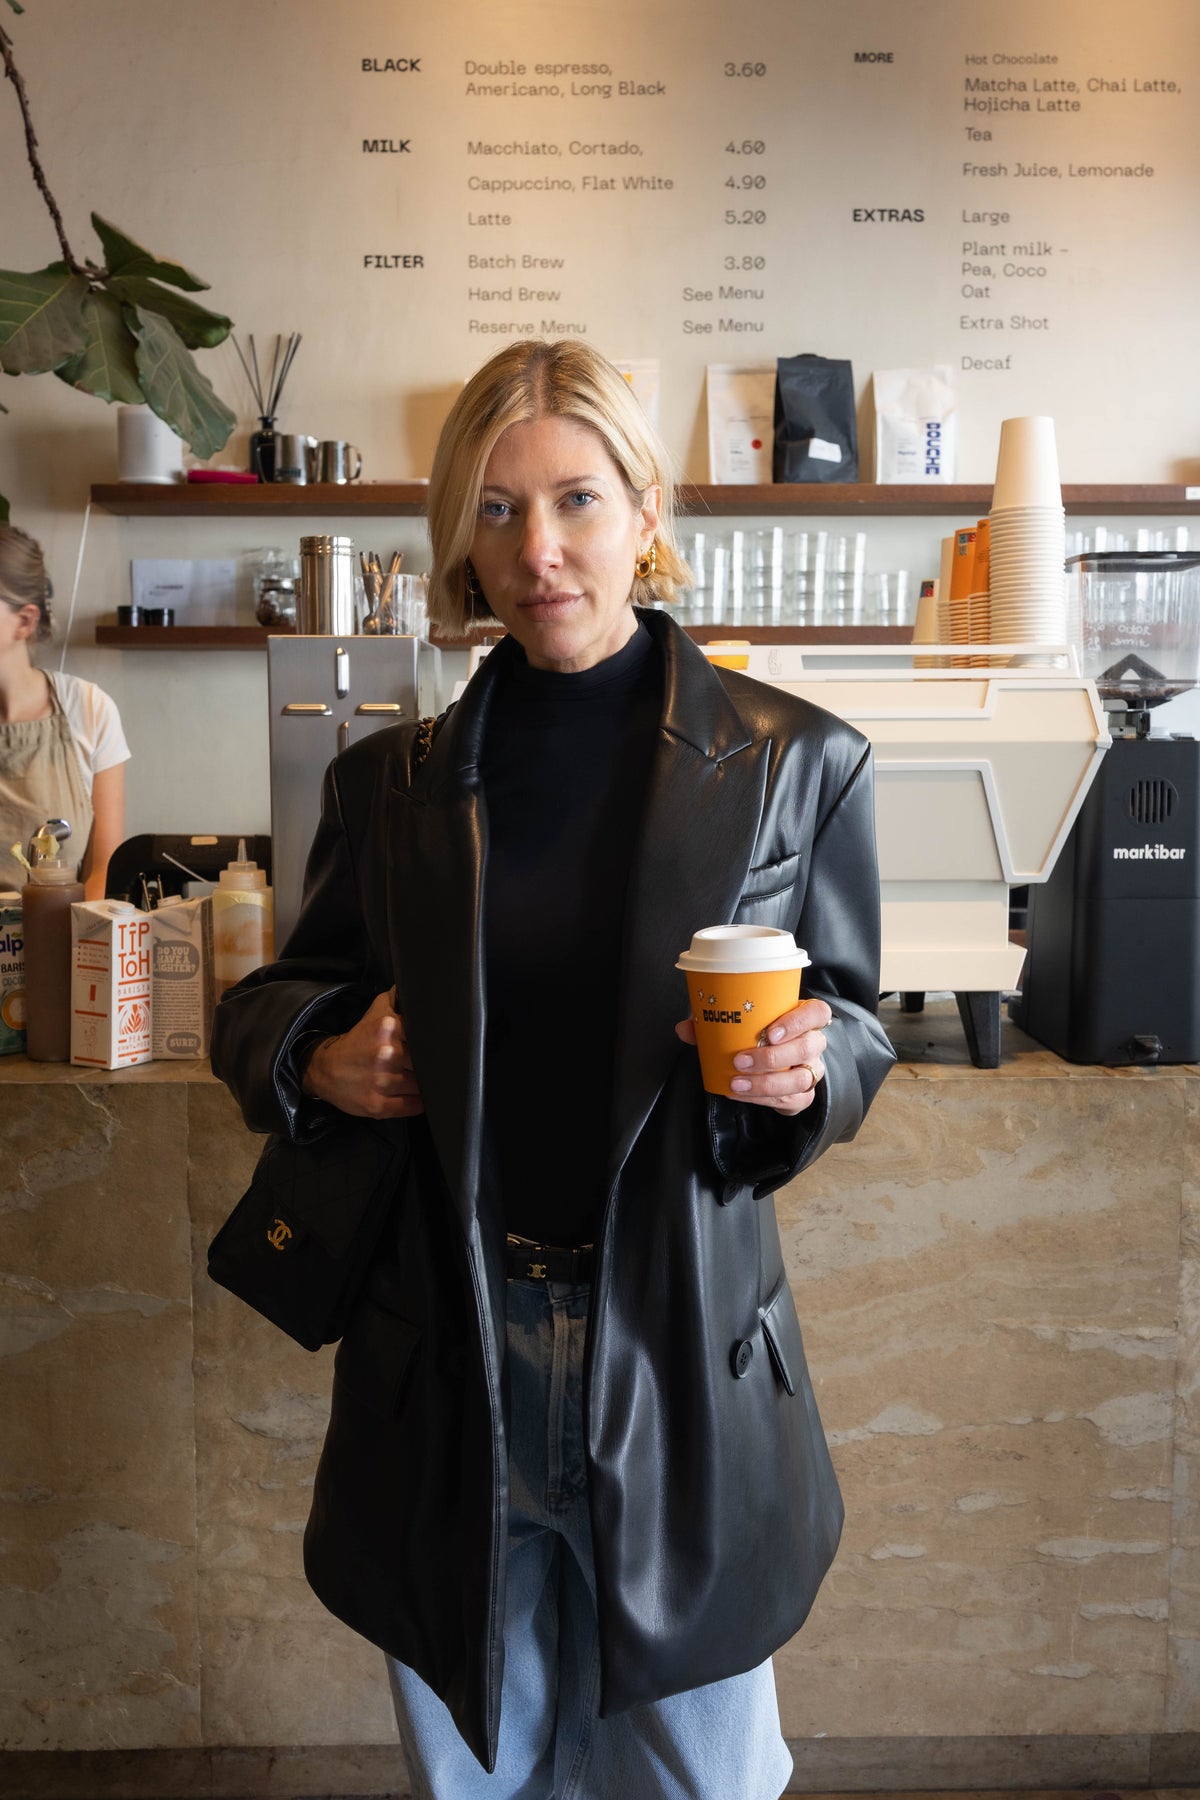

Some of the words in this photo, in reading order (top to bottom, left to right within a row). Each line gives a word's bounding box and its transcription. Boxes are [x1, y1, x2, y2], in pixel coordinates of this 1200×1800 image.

[854, 51, 894, 63] MORE
[965, 54, 988, 65] Hot
[992, 53, 1059, 65] Chocolate
[362, 58, 422, 73] BLACK
[464, 60, 526, 76] Double
[534, 62, 613, 78] espresso,
[724, 62, 767, 78] 3.60
[465, 81, 565, 98] Americano,
[571, 81, 612, 99] Long
[618, 80, 667, 96] Black
[965, 78, 1027, 93] Matcha
[1033, 78, 1081, 94] Latte,
[1087, 78, 1127, 93] Chai
[1133, 79, 1182, 94] Latte,
[963, 96, 1031, 114] Hojicha
[1037, 97, 1081, 112] Latte
[965, 127, 993, 142] Tea
[362, 139, 412, 153] MILK
[467, 141, 562, 156] Macchiato,
[569, 140, 644, 156] Cortado,
[724, 140, 766, 156] 4.60
[962, 162, 1008, 177] Fresh
[1013, 162, 1063, 179] Juice,
[1068, 163, 1155, 178] Lemonade
[468, 176, 576, 193] Cappuccino,
[582, 175, 617, 191] Flat
[622, 175, 675, 191] White
[724, 174, 767, 190] 4.90
[468, 211, 512, 226] Latte
[724, 209, 767, 225] 5.20
[852, 208, 925, 223] EXTRAS
[962, 209, 1011, 226] Large
[962, 241, 1007, 256] Plant
[1013, 241, 1053, 256] milk
[363, 254, 425, 269] FILTER
[468, 254, 516, 269] Batch
[521, 255, 565, 270] Brew
[724, 255, 767, 271] 3.80
[961, 262, 997, 279] Pea,
[1003, 263, 1048, 278] Coco
[468, 287, 513, 302] Hand
[518, 287, 562, 302] Brew
[682, 287, 713, 301] See
[718, 285, 765, 301] Menu
[961, 284, 991, 299] Oat
[468, 319, 535, 335] Reserve
[541, 319, 587, 334] Menu
[682, 319, 713, 334] See
[718, 318, 765, 333] Menu
[960, 315, 1005, 330] Extra
[1010, 315, 1049, 330] Shot
[961, 354, 1013, 371] Decaf
[925, 422, 941, 475] BOUCHE
[1113, 843, 1186, 860] markibar
[171, 946, 190, 955] YOU
[703, 1009, 742, 1024] BOUCHE
